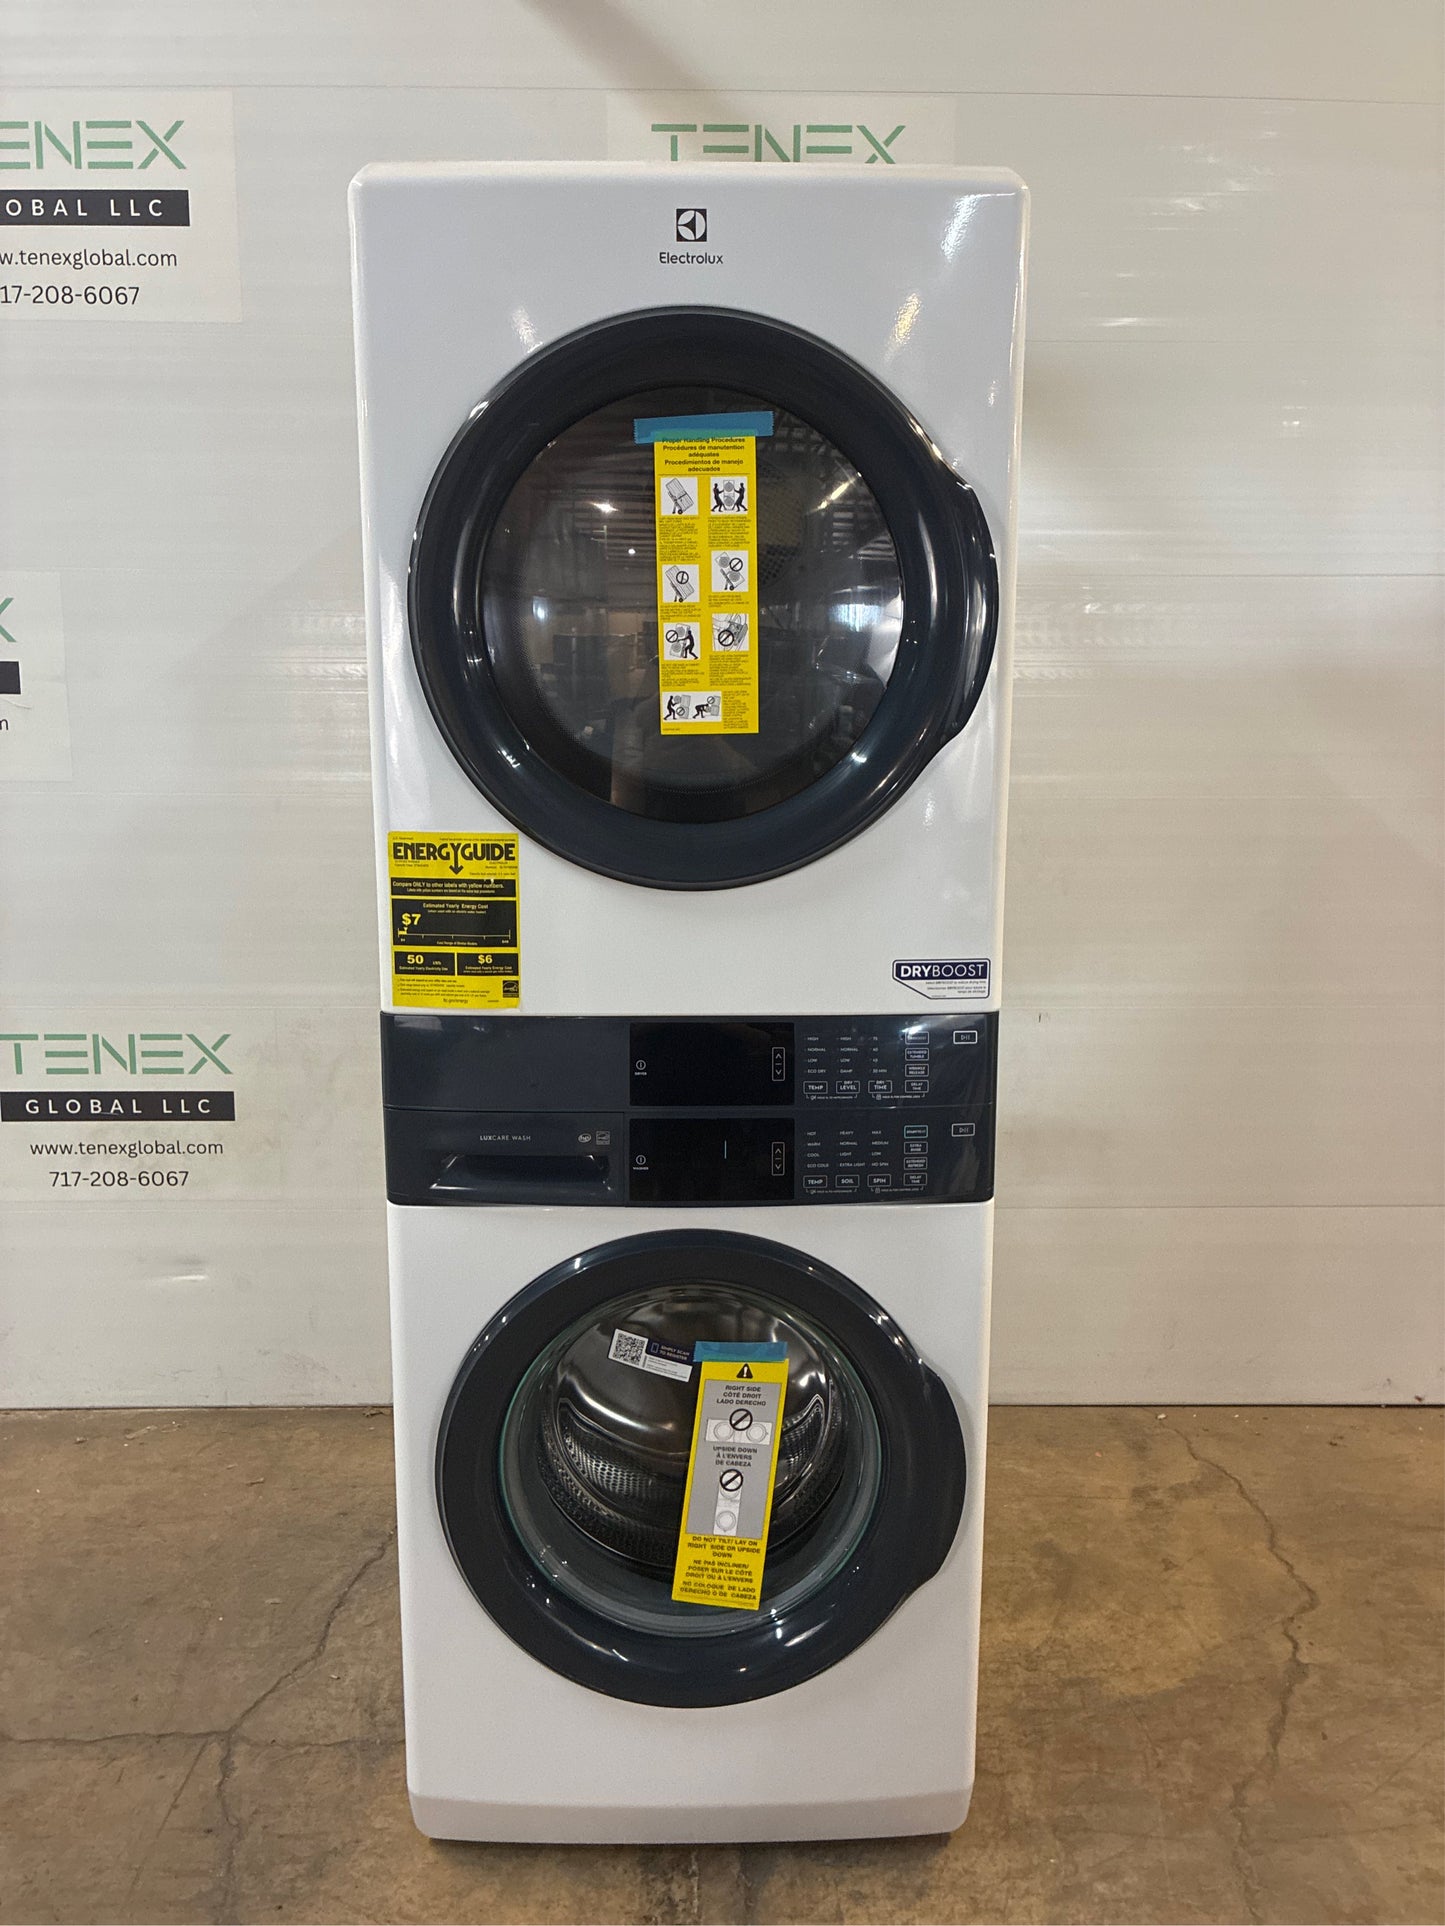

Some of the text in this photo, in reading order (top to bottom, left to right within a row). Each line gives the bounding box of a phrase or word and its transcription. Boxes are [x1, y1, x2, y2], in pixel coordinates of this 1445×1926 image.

[651, 124, 906, 164] TENEX
[110, 199, 163, 216] LLC
[659, 252, 724, 265] Electrolux
[401, 912, 422, 926] $7
[407, 954, 424, 965] 50
[477, 954, 493, 965] $6
[900, 963, 985, 978] DRYBOOST
[0, 1034, 233, 1074] TENEX
[25, 1099, 211, 1114] GLOBAL LLC
[30, 1140, 224, 1158] www.tenexglobal.com
[49, 1171, 190, 1187] 717-208-6067
